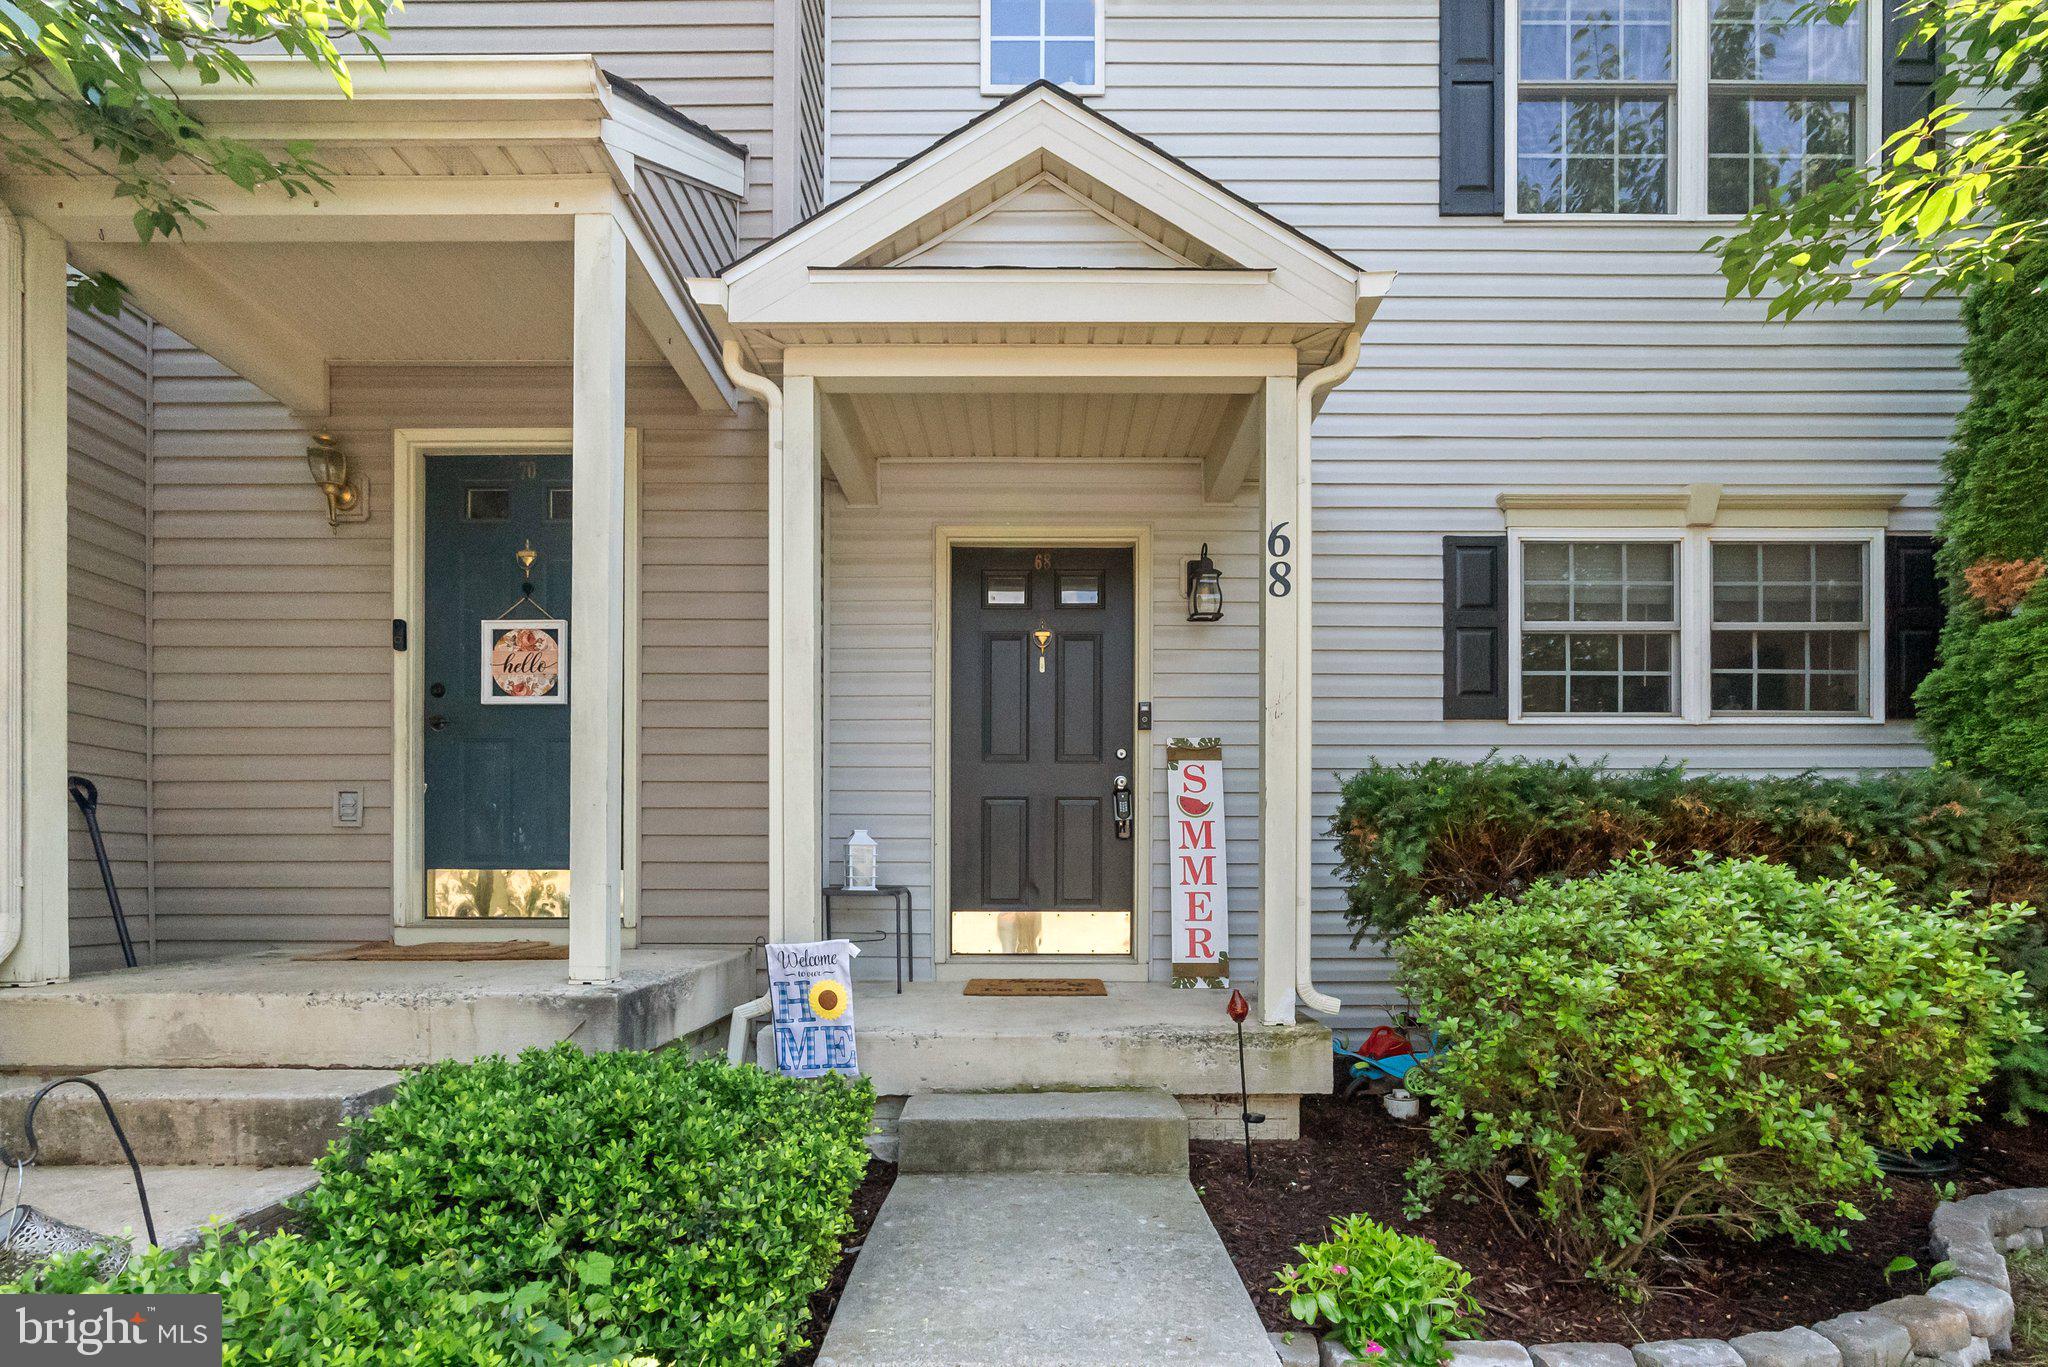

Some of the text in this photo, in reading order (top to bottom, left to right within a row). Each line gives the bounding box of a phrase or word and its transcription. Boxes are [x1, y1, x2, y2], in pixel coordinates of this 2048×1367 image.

[1034, 554, 1051, 569] 68
[1268, 521, 1291, 597] 68
[490, 651, 557, 675] hello
[777, 949, 838, 969] Welcome
